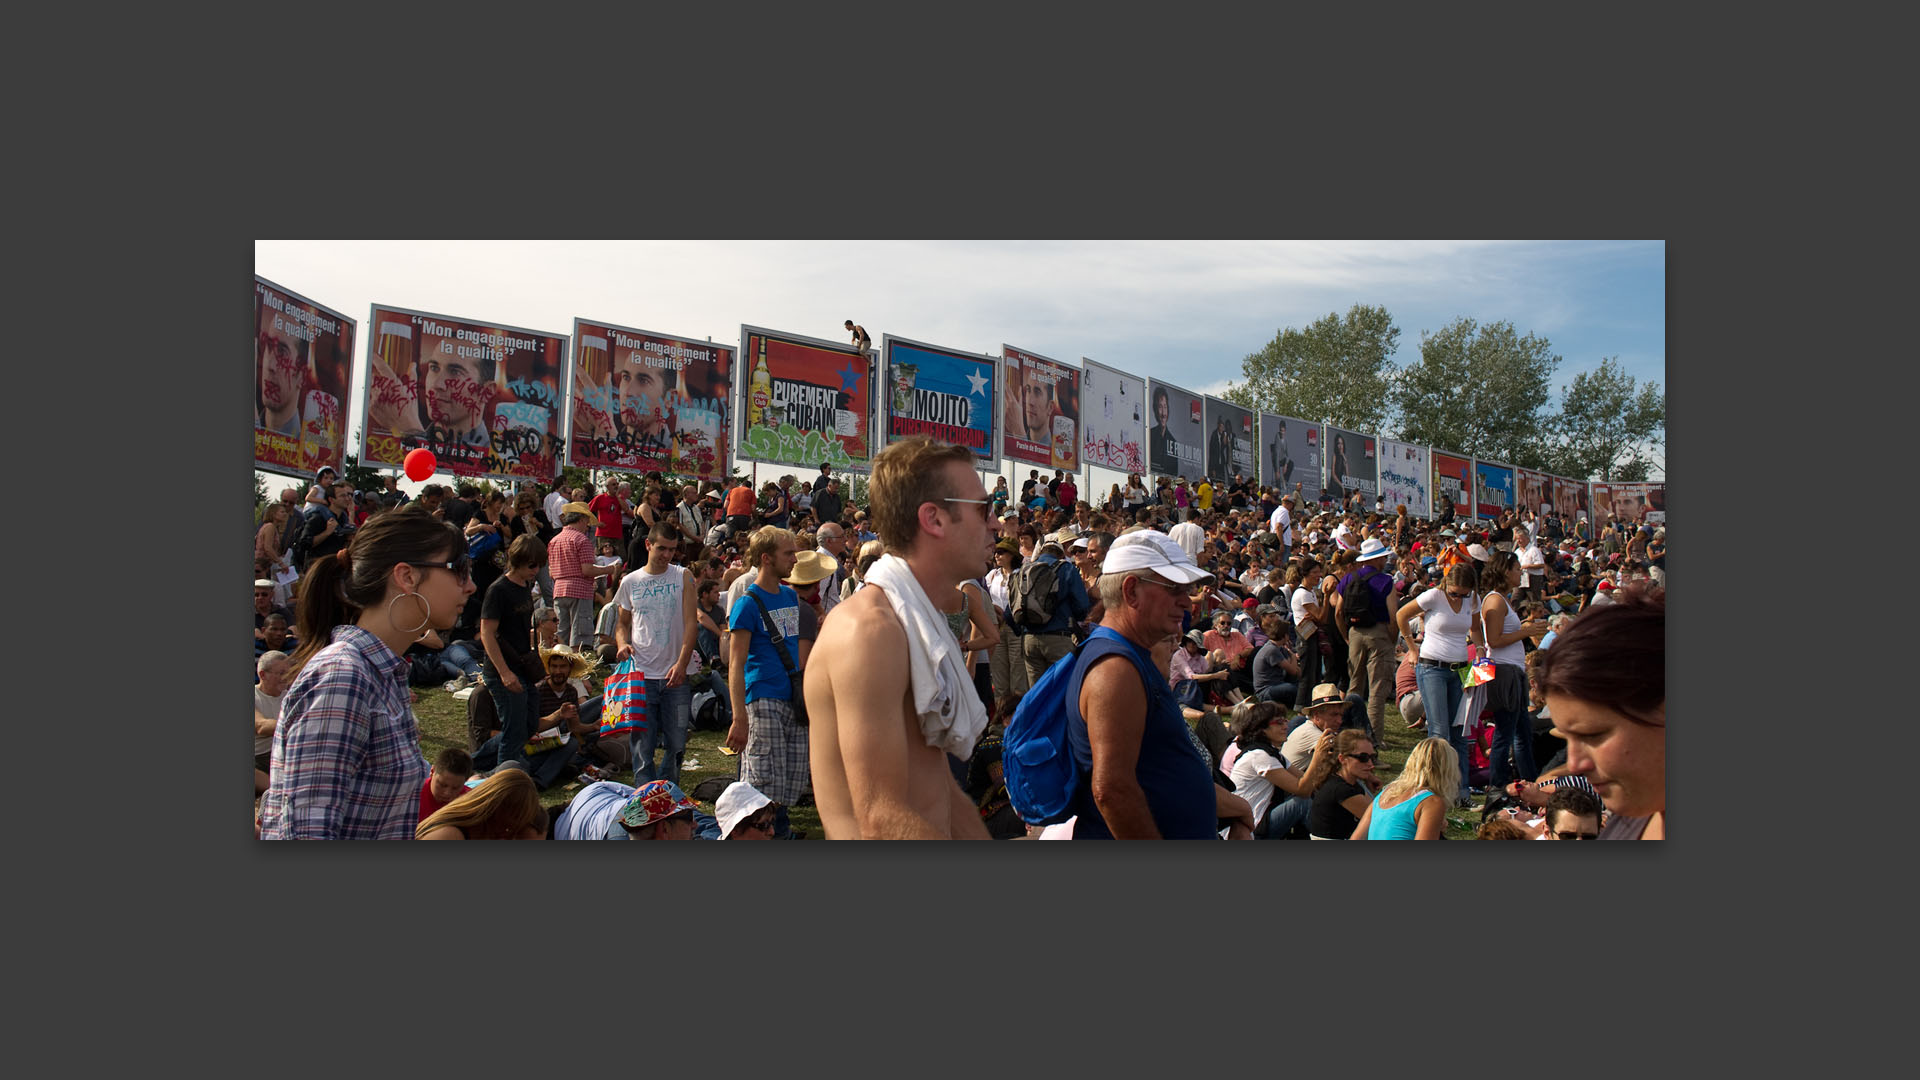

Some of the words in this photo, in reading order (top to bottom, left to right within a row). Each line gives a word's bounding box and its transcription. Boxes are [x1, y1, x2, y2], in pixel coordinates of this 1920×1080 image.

[274, 313, 282, 330] la
[285, 303, 336, 335] engagement
[440, 340, 454, 354] la
[456, 328, 537, 352] engagement
[643, 340, 710, 362] engagement
[631, 351, 641, 364] la
[773, 380, 838, 409] PUREMENT
[786, 402, 836, 433] CUBAIN
[914, 389, 969, 427] MOJITO
[948, 424, 985, 449] CUBAIN
